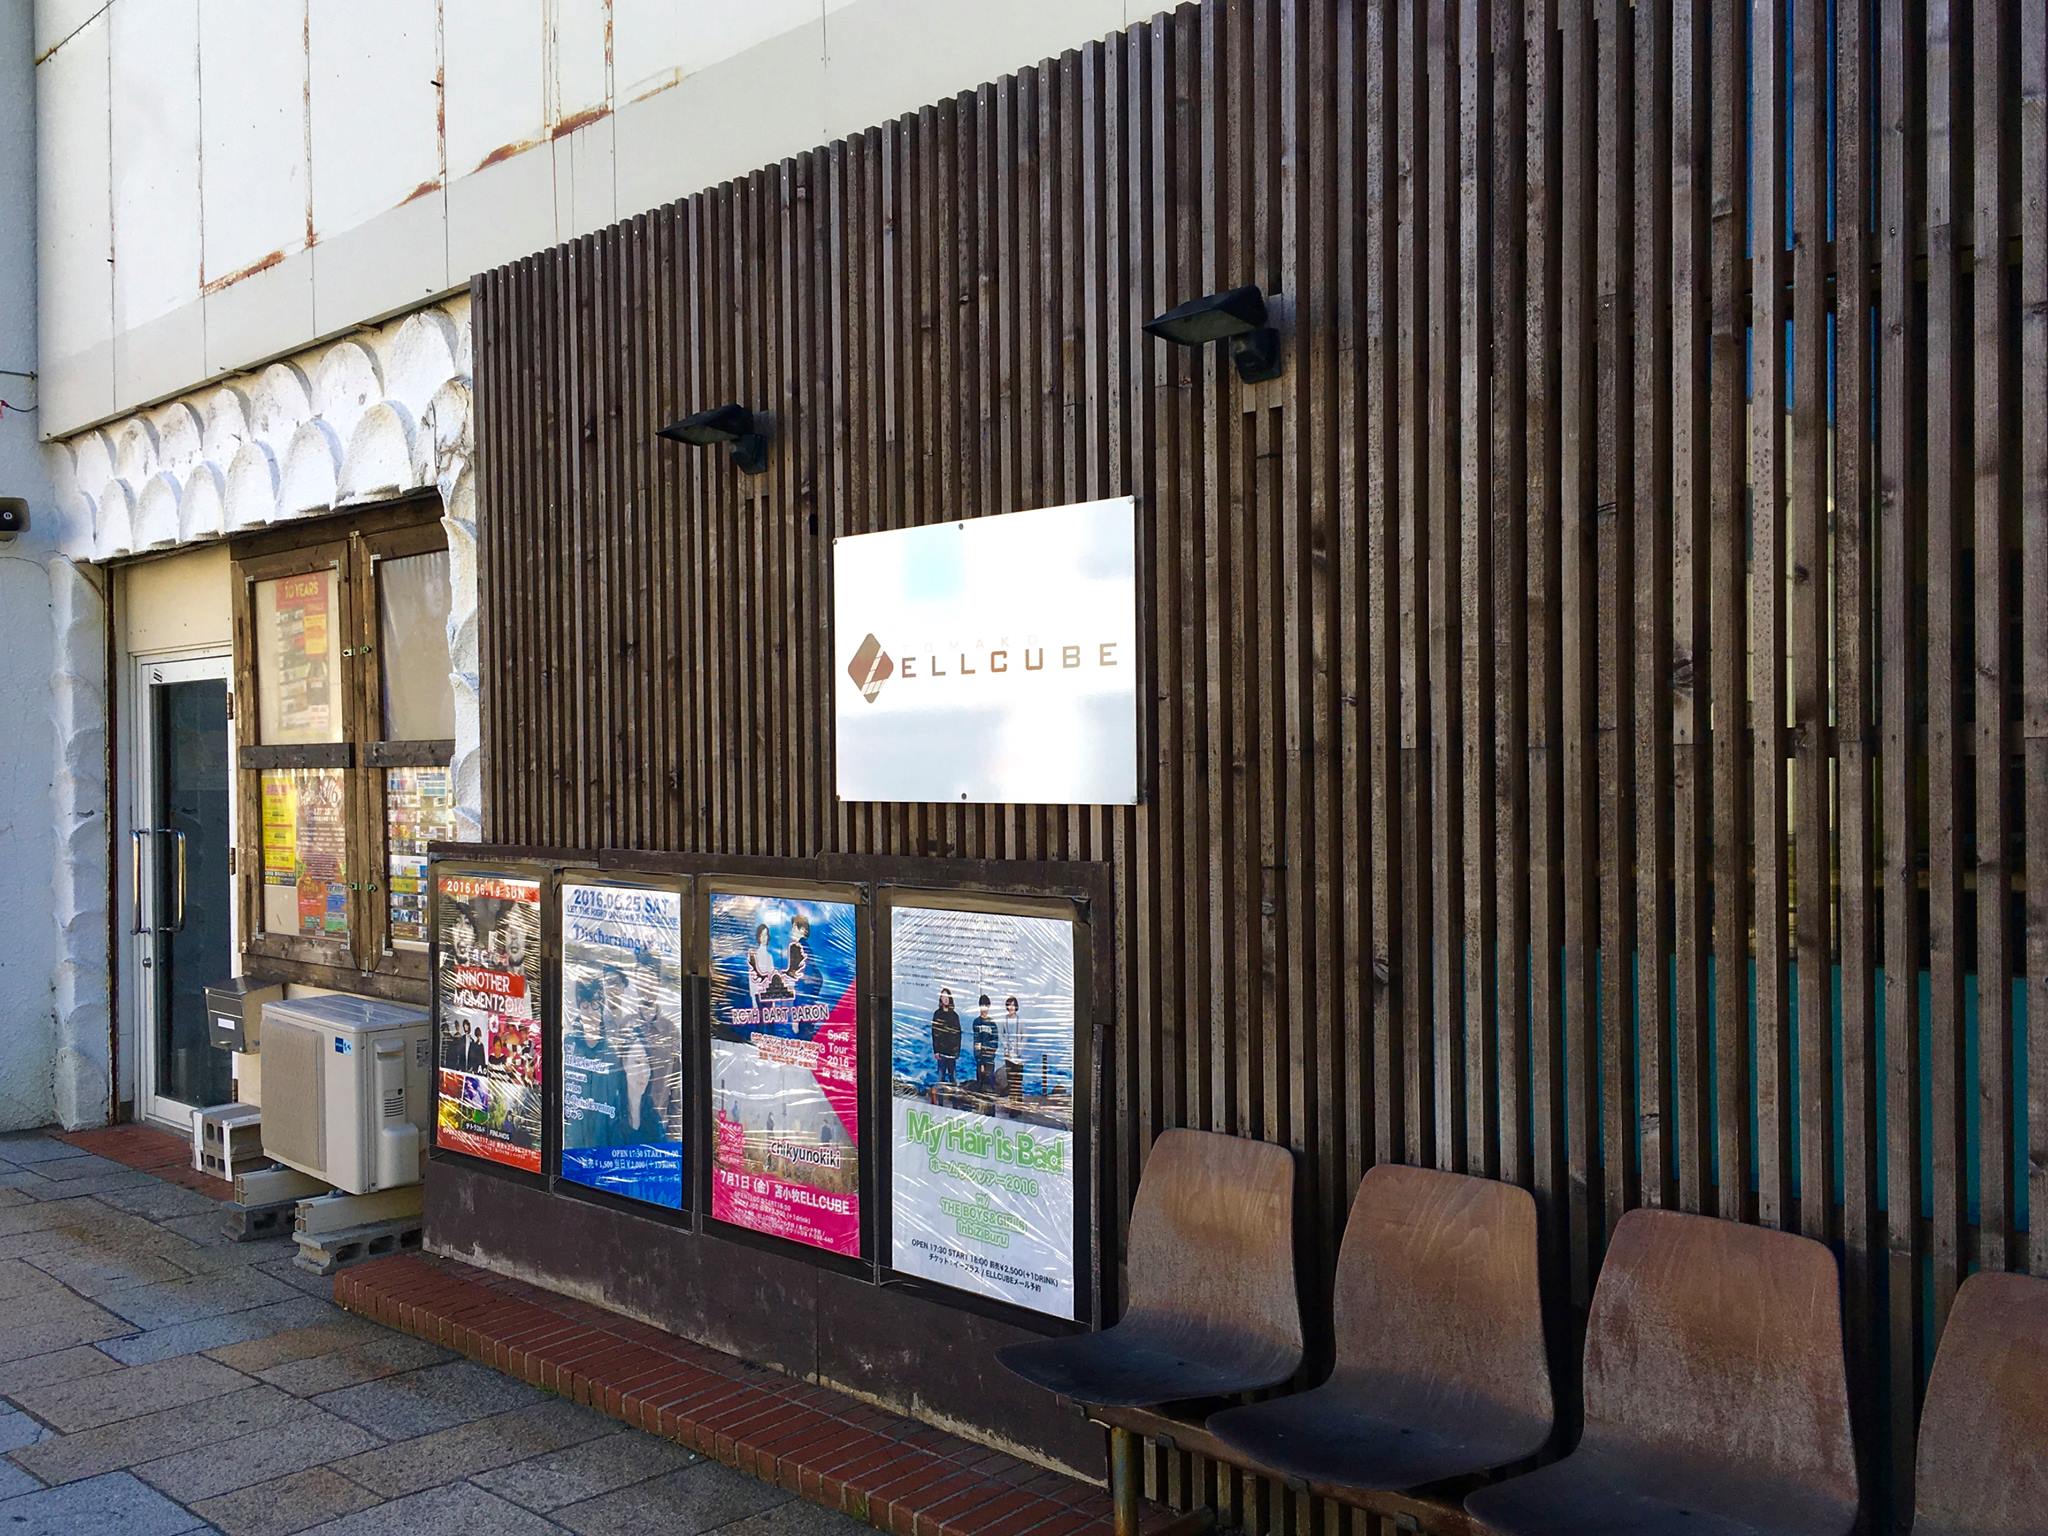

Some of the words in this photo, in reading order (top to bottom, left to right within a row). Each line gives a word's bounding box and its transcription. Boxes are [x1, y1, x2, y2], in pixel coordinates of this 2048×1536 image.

[902, 643, 1117, 678] ELLCUBE
[446, 880, 500, 897] 2016.06.19
[505, 886, 525, 899] SUN
[574, 889, 641, 912] 2016.06.25
[644, 896, 670, 914] SAT
[731, 1008, 760, 1024] ROTH
[762, 1007, 790, 1023] BART
[791, 1004, 829, 1020] BARON
[828, 1042, 848, 1054] Tour
[827, 1055, 849, 1067] 2016
[906, 1108, 944, 1155] My
[946, 1117, 993, 1160] Hair
[993, 1126, 1015, 1164] is
[1015, 1132, 1064, 1176] Bad
[611, 1149, 628, 1158] OPEN
[769, 1140, 841, 1169] chikyunokiki
[941, 1198, 962, 1217] THE
[911, 1238, 929, 1250] OPEN
[929, 1243, 947, 1255] 17:30
[947, 1247, 969, 1261] START
[970, 1255, 989, 1267] 18:00
